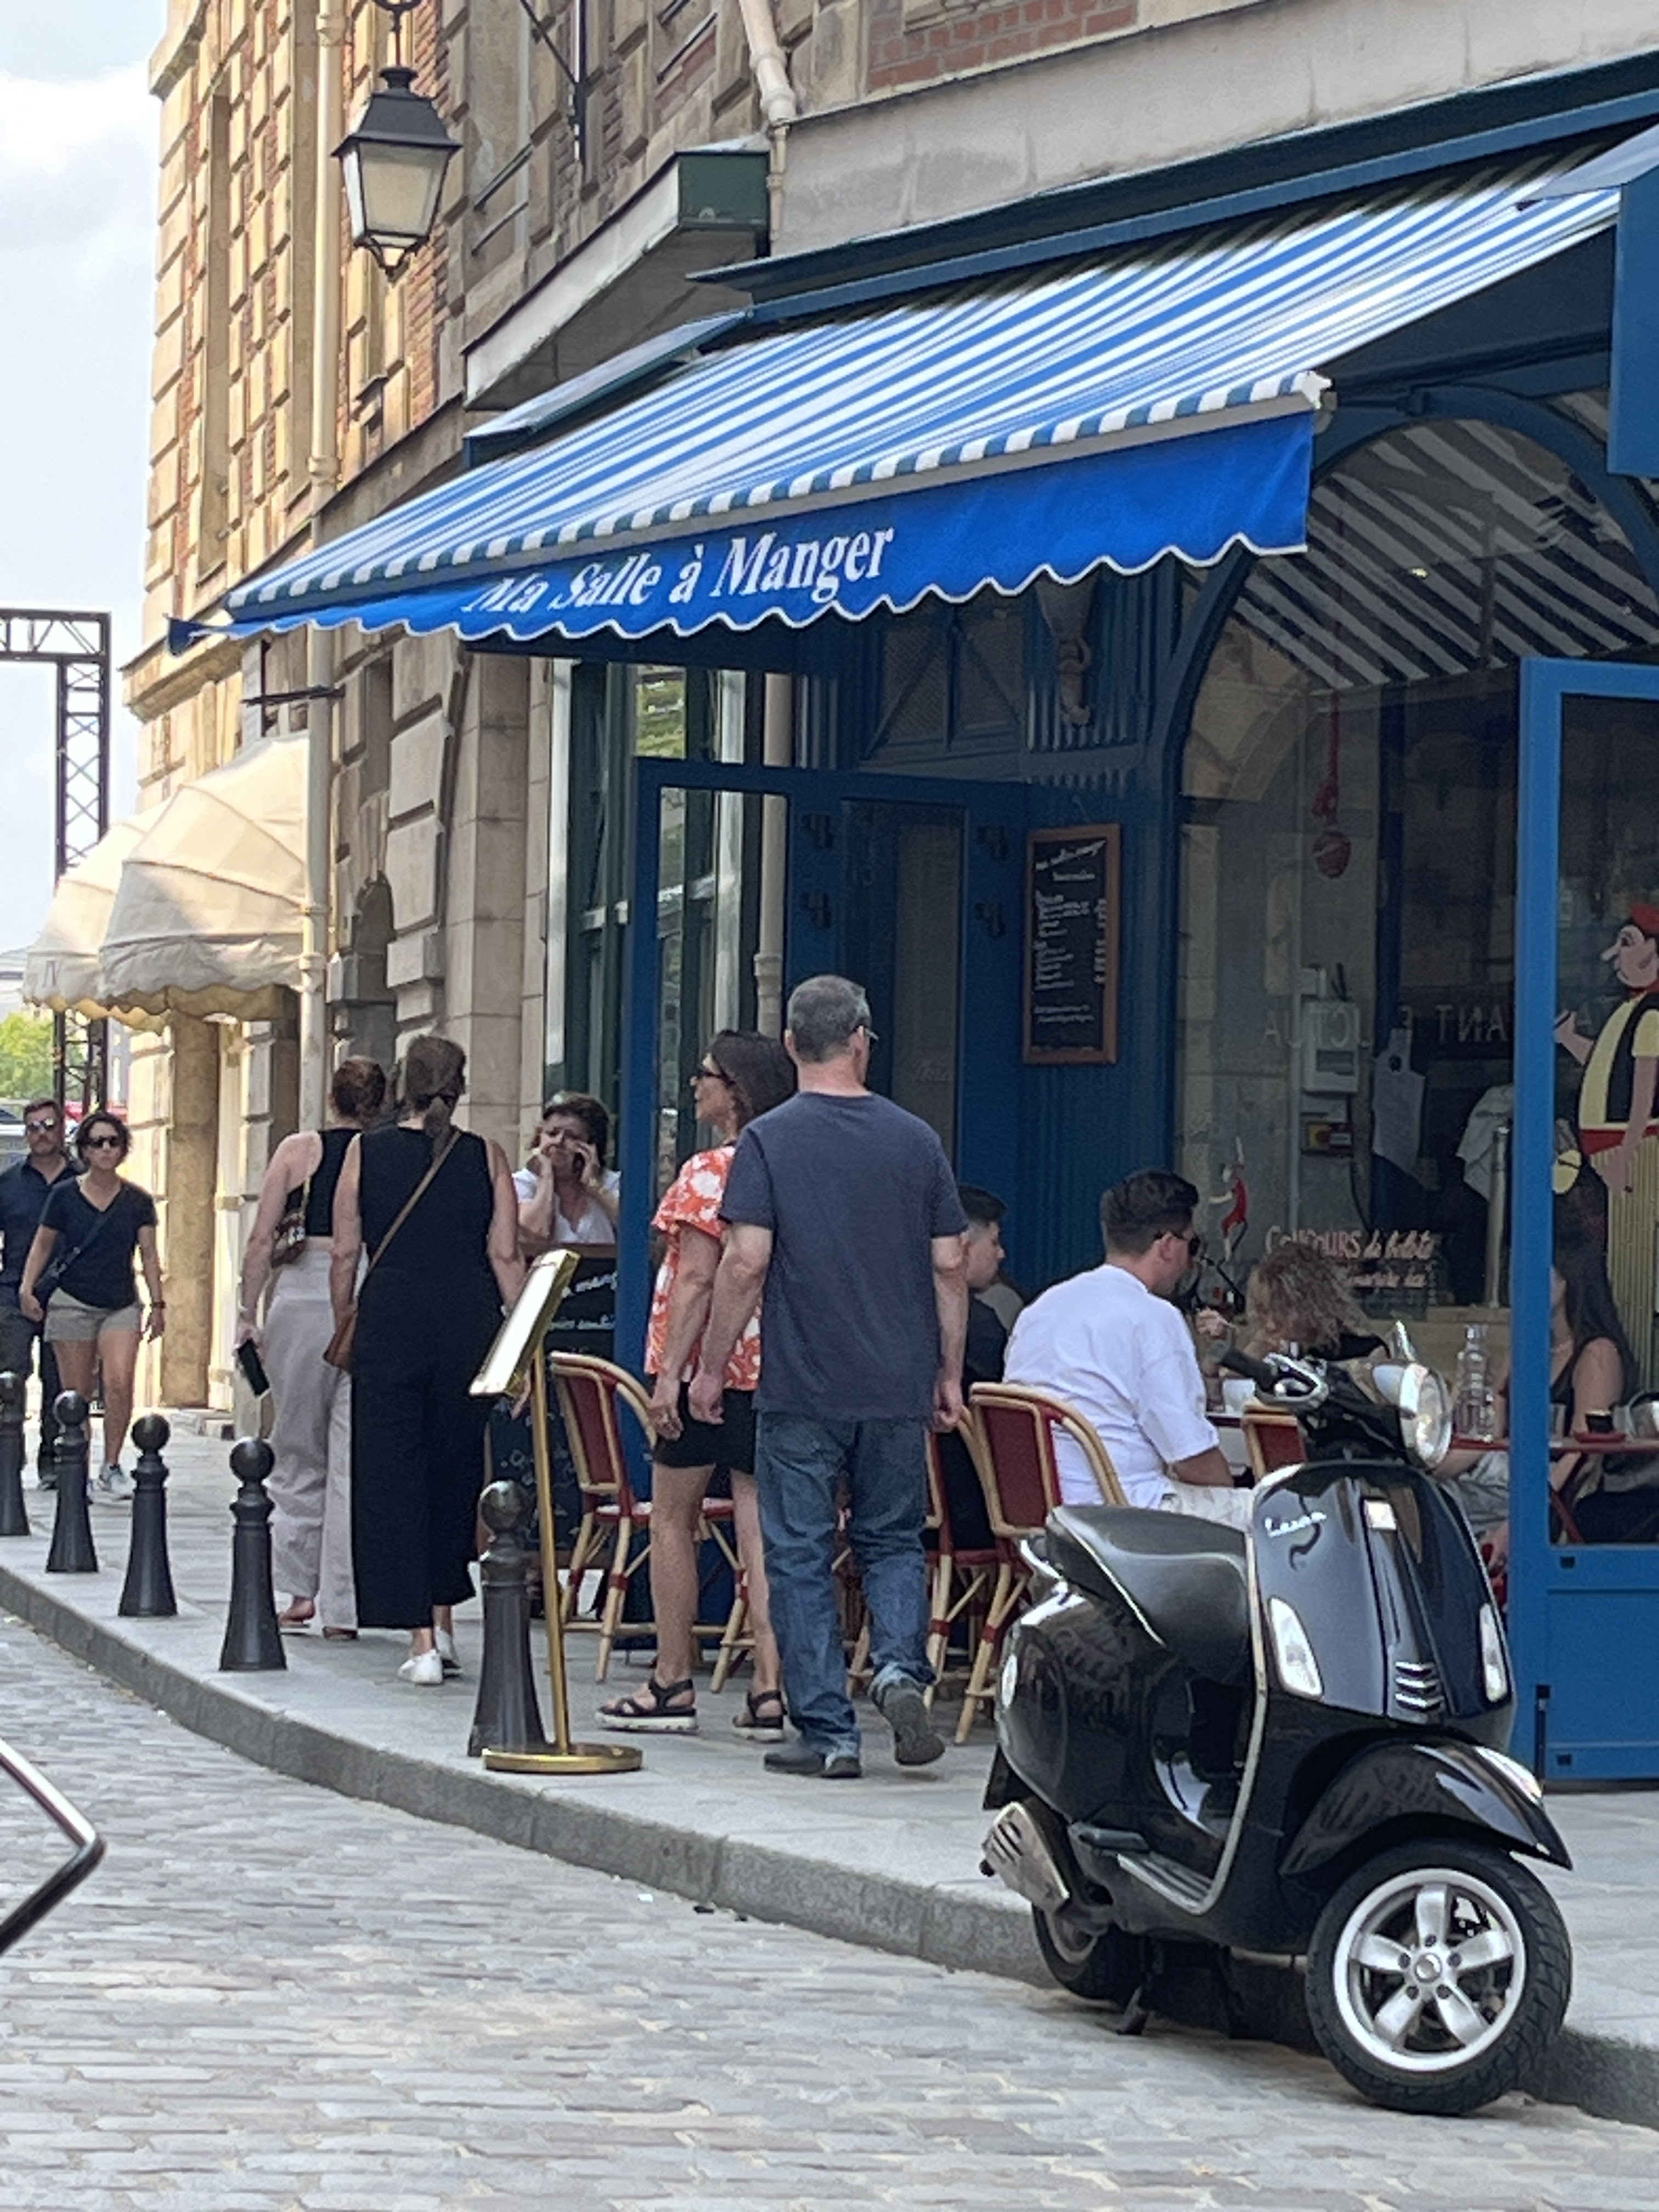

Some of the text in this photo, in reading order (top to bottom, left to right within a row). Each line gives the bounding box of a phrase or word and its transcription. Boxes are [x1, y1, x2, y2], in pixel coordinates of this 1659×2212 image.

[461, 527, 895, 614] Ma Salle à Manger
